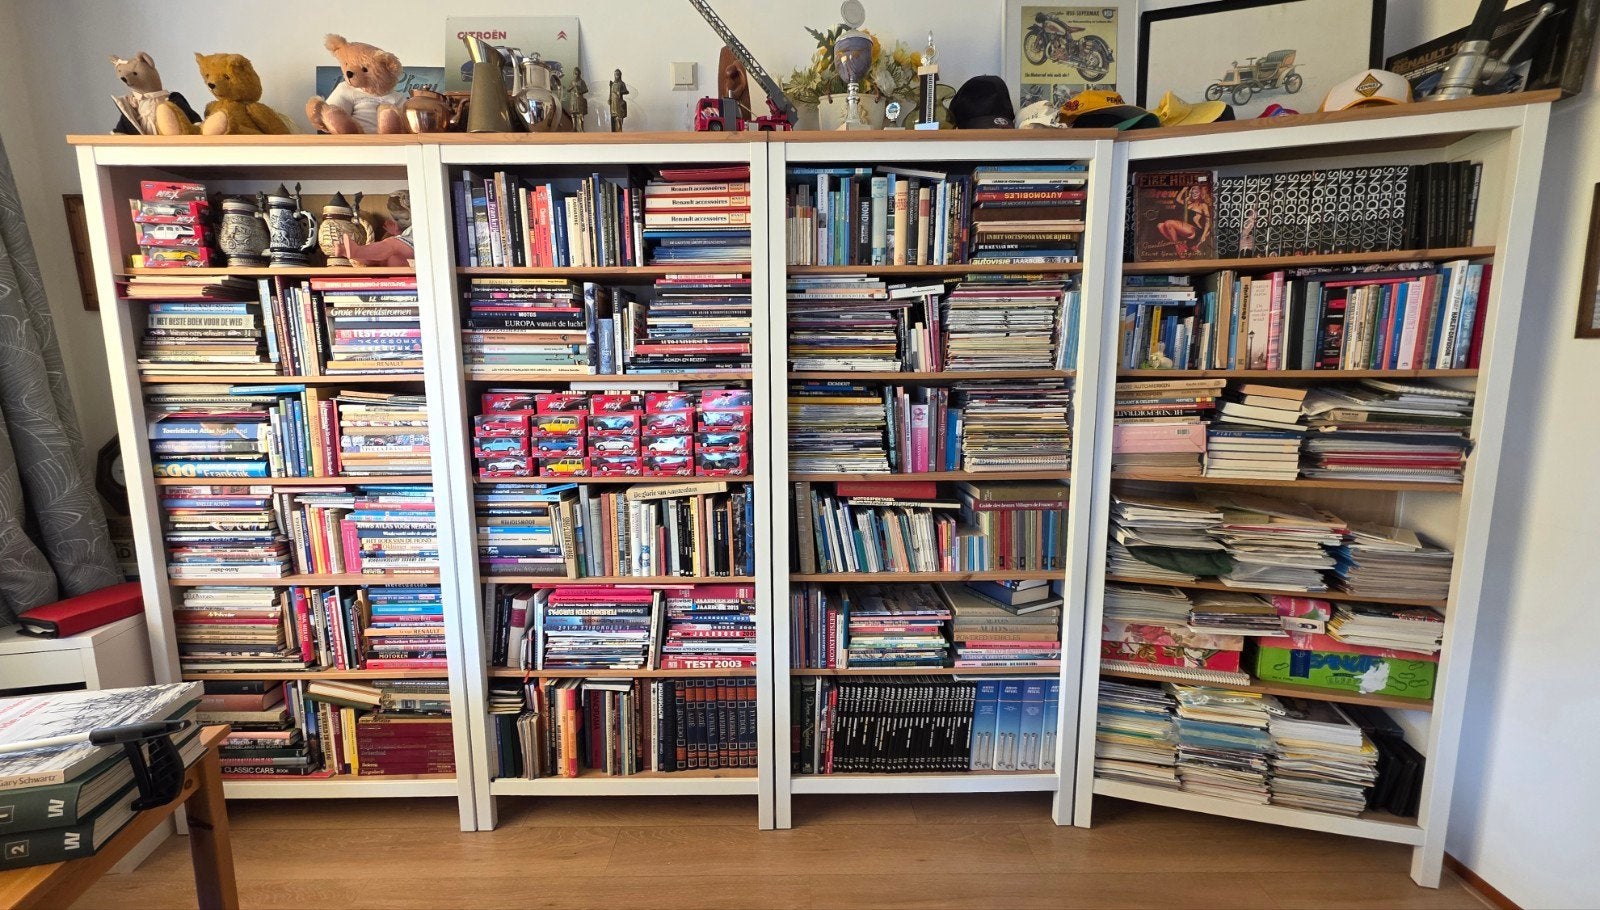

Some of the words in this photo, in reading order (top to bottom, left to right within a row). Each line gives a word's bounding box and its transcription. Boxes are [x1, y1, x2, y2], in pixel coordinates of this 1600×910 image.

[1218, 179, 1232, 227] SNOECKS
[1230, 179, 1244, 228] SNOECKS
[1257, 177, 1271, 228] SNOECKS
[1270, 175, 1286, 225] SNOECKS
[1284, 174, 1299, 225] SNOECKS
[1296, 174, 1312, 225] SNOECKS
[1310, 173, 1326, 224] SNOECKS
[1324, 171, 1340, 223] SNOECKS
[1338, 171, 1354, 223] SNOECKS
[1351, 169, 1368, 222] SNOECKS
[1366, 167, 1382, 221] SNOECKS
[1378, 167, 1395, 220] SNOECKS
[1392, 166, 1409, 219] SNOECKS
[157, 317, 167, 326] HET
[169, 317, 186, 326] BESTE
[187, 317, 202, 326] BOEK
[204, 317, 219, 326] VOOR
[221, 317, 228, 326] DE
[229, 317, 243, 326] WEG
[331, 308, 352, 316] Grote
[354, 308, 411, 316] Wereldstromen
[154, 464, 196, 477] 500
[828, 613, 836, 662] FIETSENLEXICON
[19, 775, 55, 783] Schwartz
[48, 799, 64, 818] W
[64, 832, 80, 850] W
